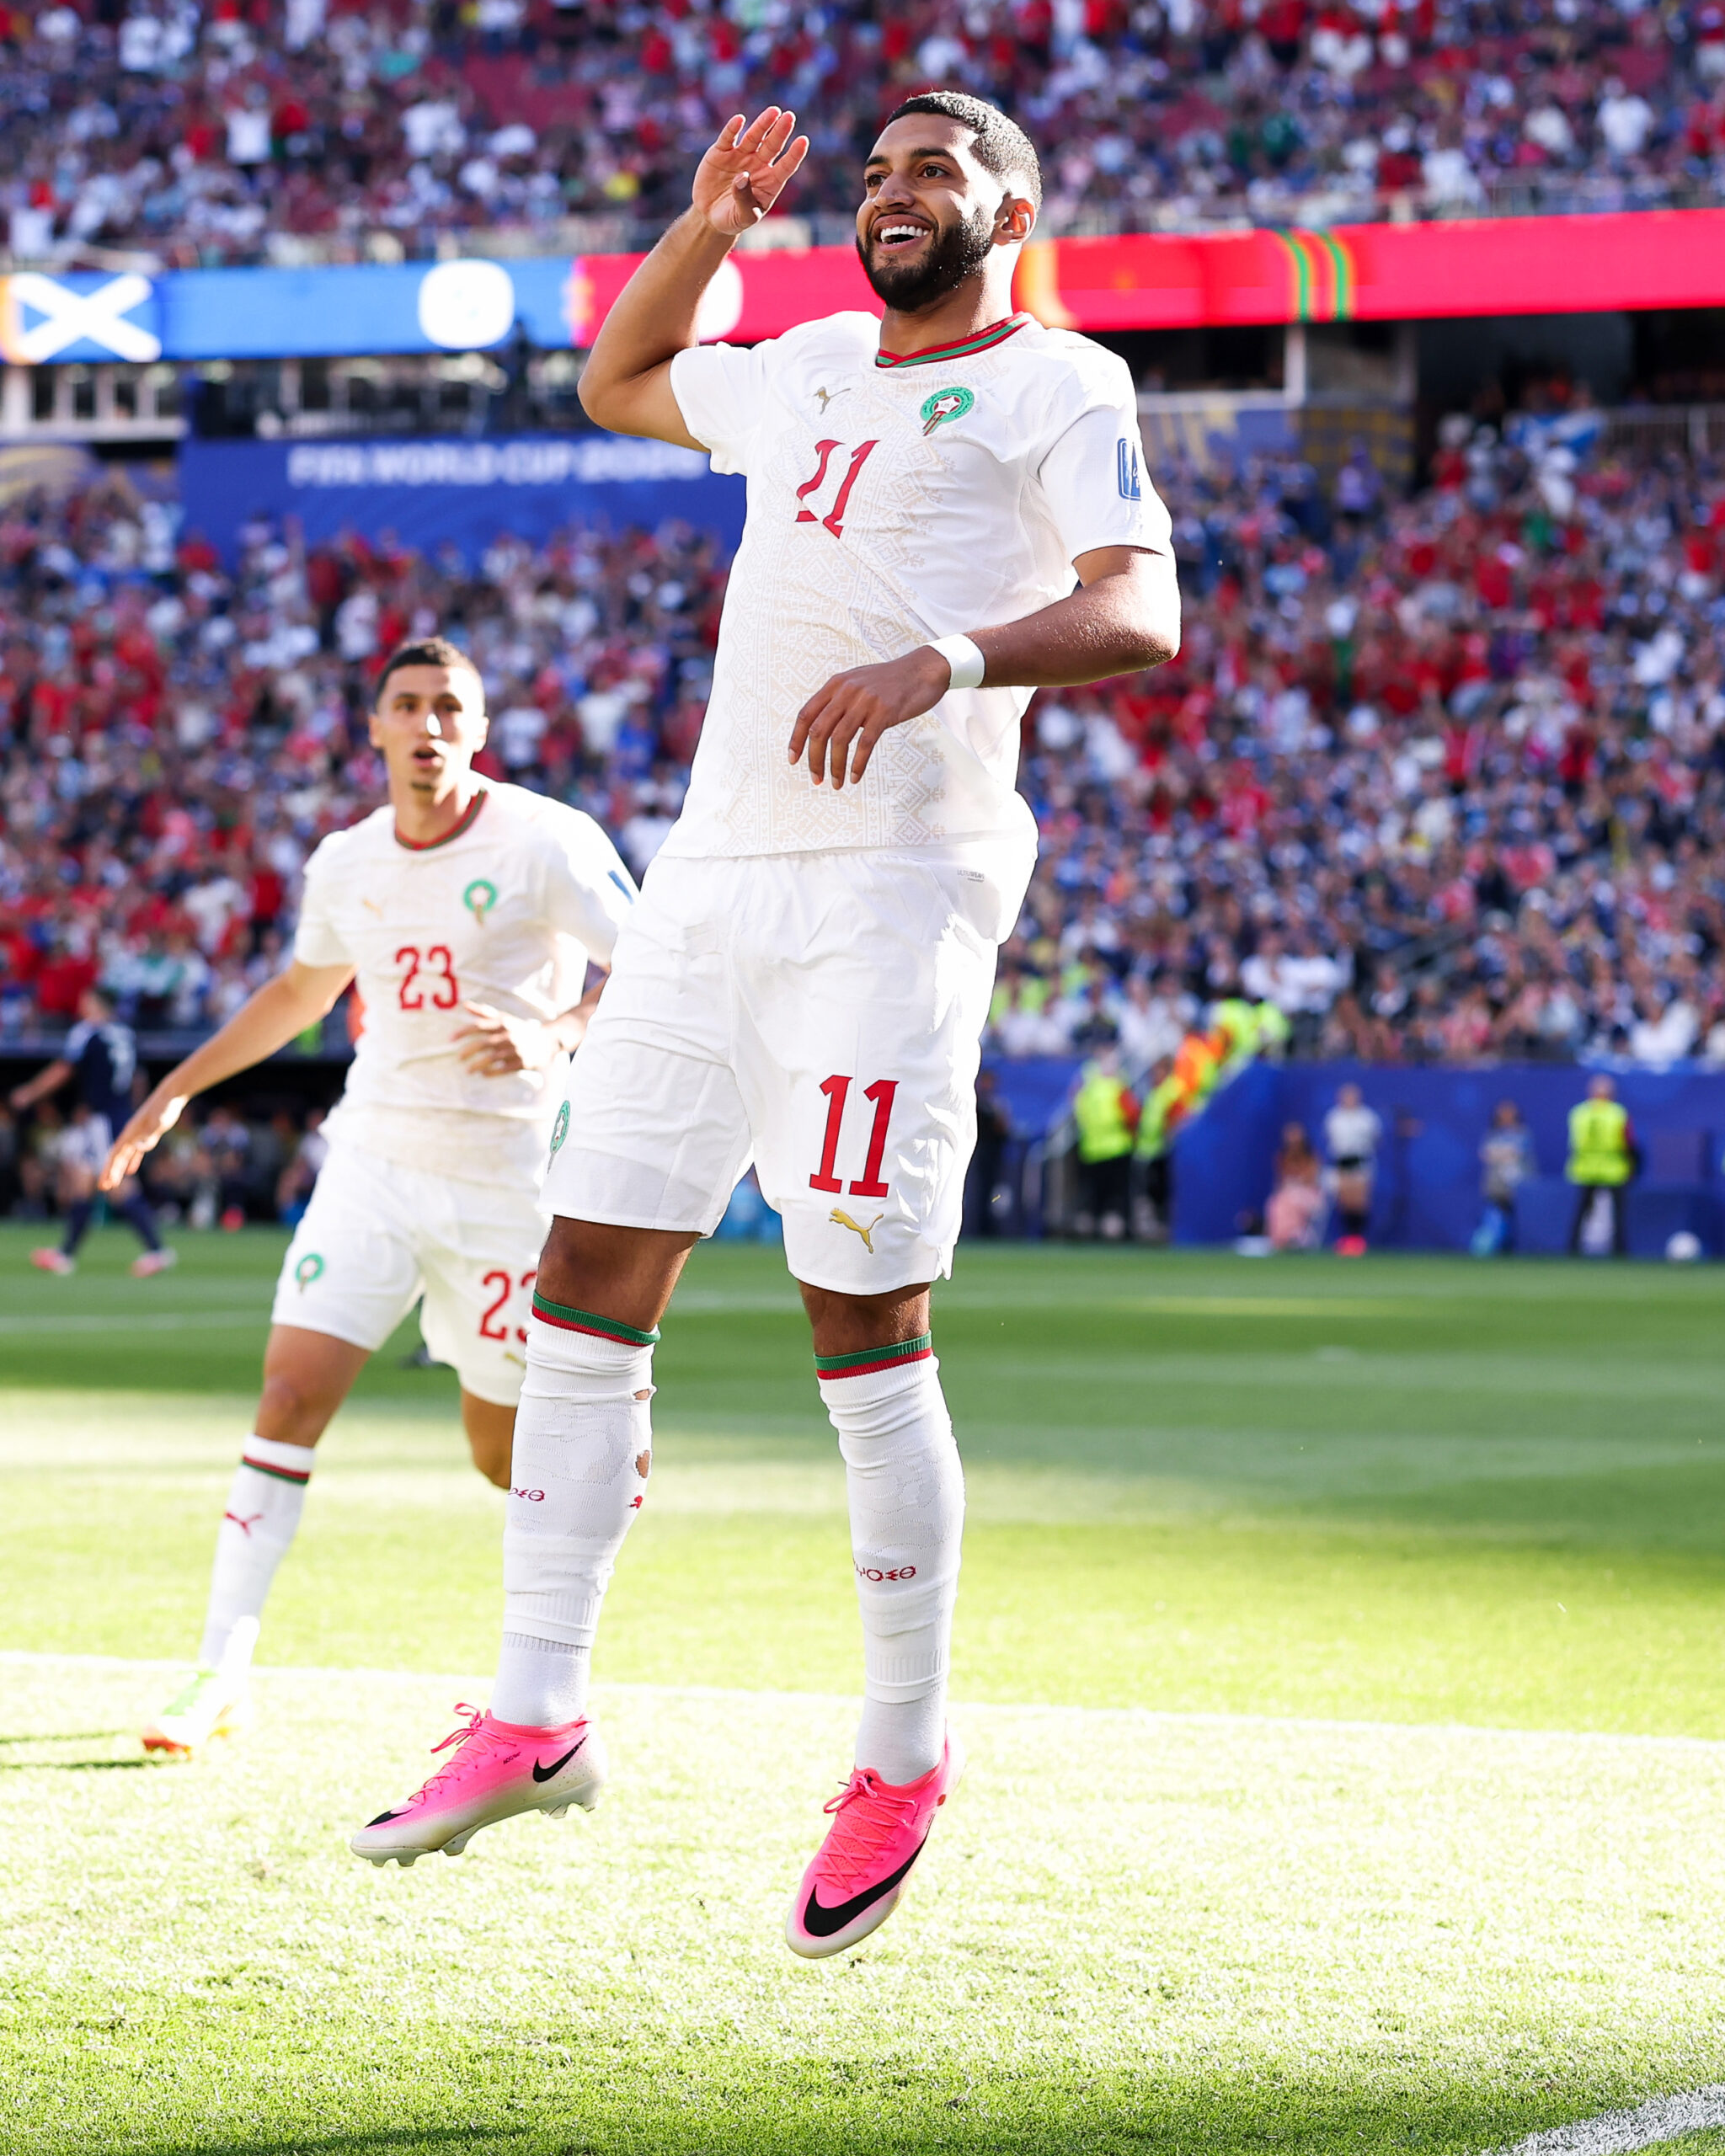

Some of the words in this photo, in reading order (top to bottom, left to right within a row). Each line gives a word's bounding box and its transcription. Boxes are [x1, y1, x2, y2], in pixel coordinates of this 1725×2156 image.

[287, 442, 364, 488] FIFA
[371, 441, 497, 488] WORLD
[502, 440, 573, 486] CUP
[395, 947, 457, 1010] 23
[809, 1075, 900, 1198] 11
